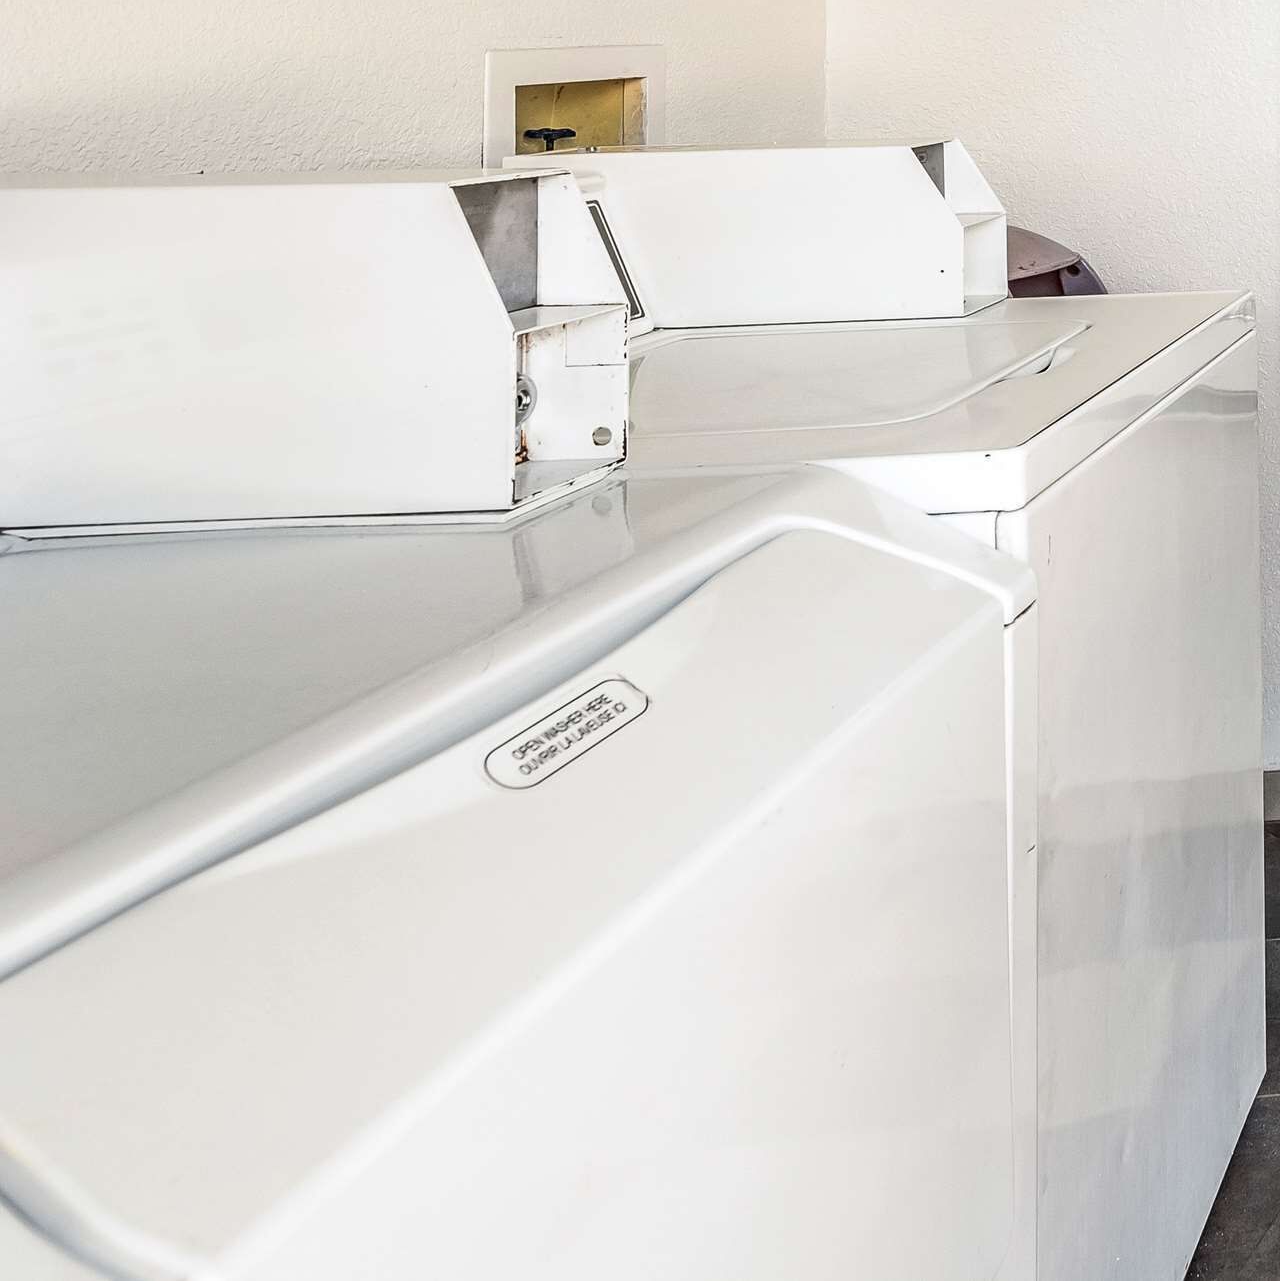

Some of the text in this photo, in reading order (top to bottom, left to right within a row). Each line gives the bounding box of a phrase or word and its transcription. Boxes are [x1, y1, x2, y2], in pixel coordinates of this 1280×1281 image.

[511, 693, 613, 760] OPEN WASHER HERE
